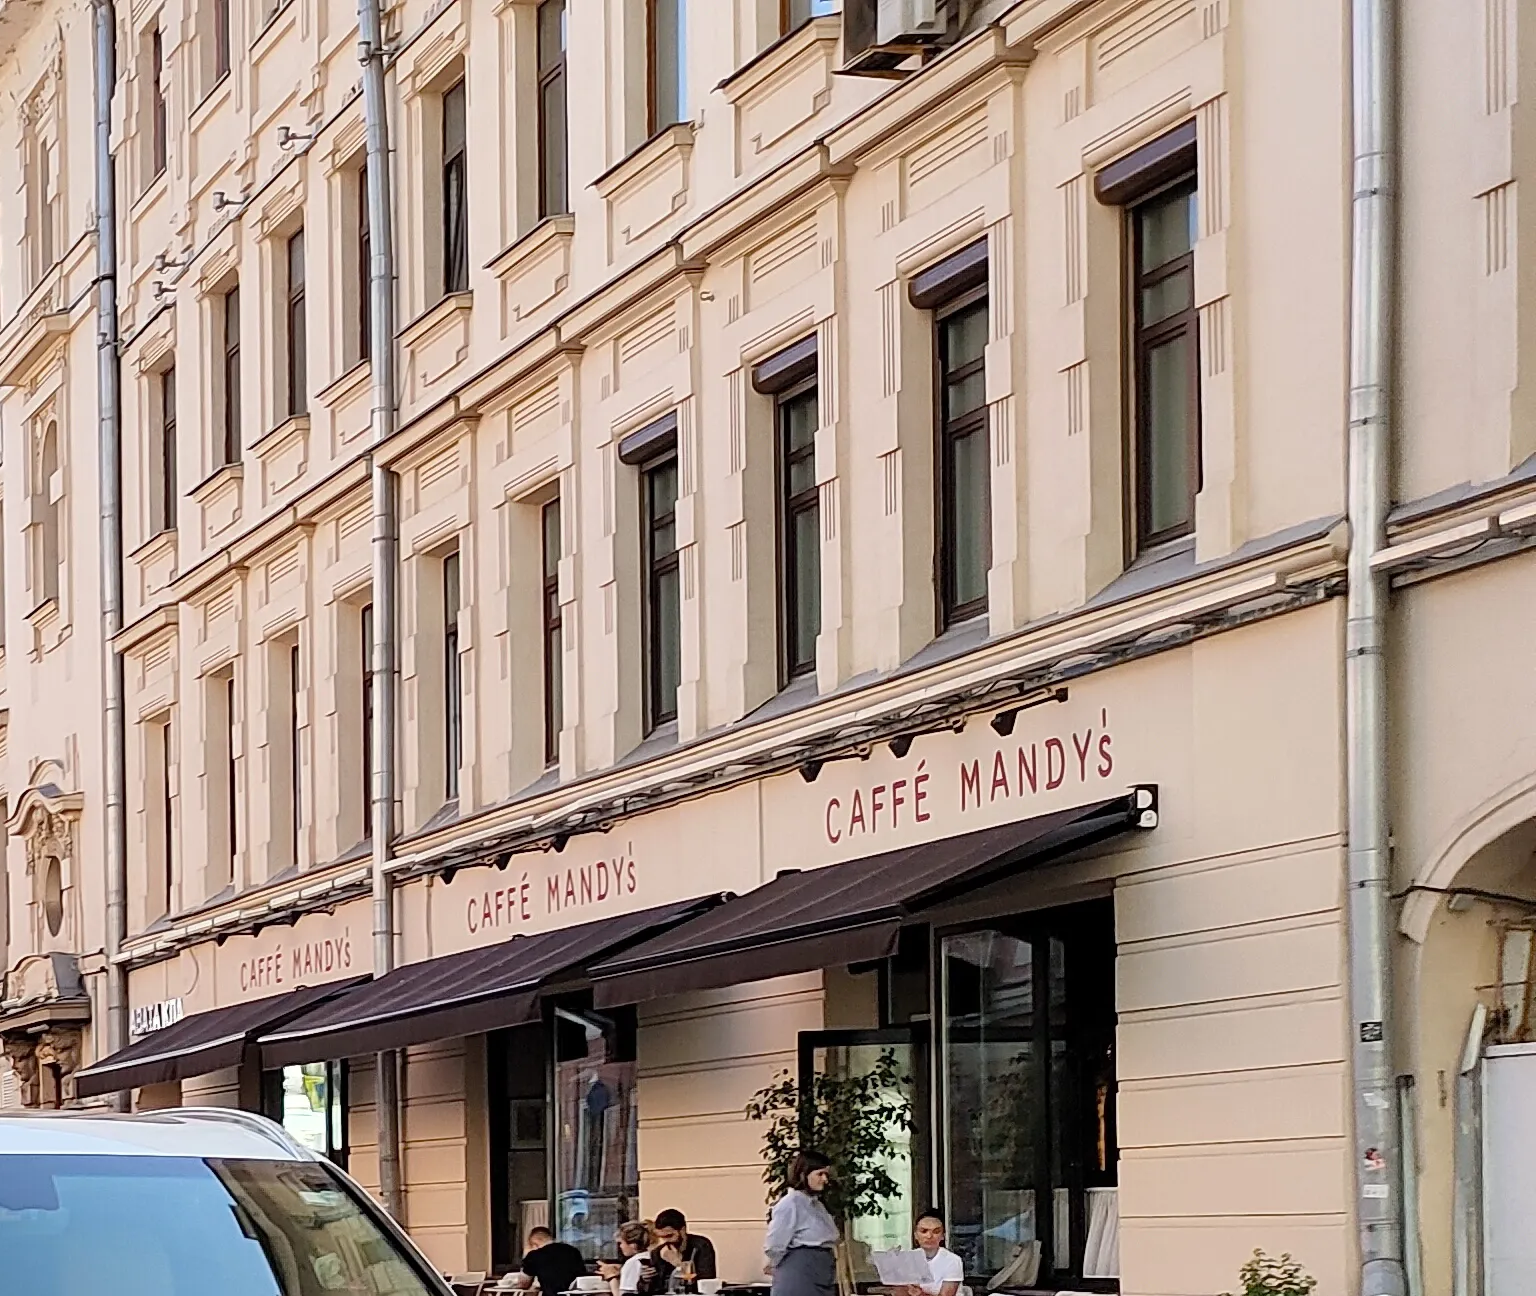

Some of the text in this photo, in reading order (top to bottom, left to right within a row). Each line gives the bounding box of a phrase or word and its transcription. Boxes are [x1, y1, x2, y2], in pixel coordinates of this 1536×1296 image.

[826, 758, 931, 844] CAFFÉ
[467, 871, 531, 934] CAFFÉ
[240, 943, 284, 992] CAFFÉ
